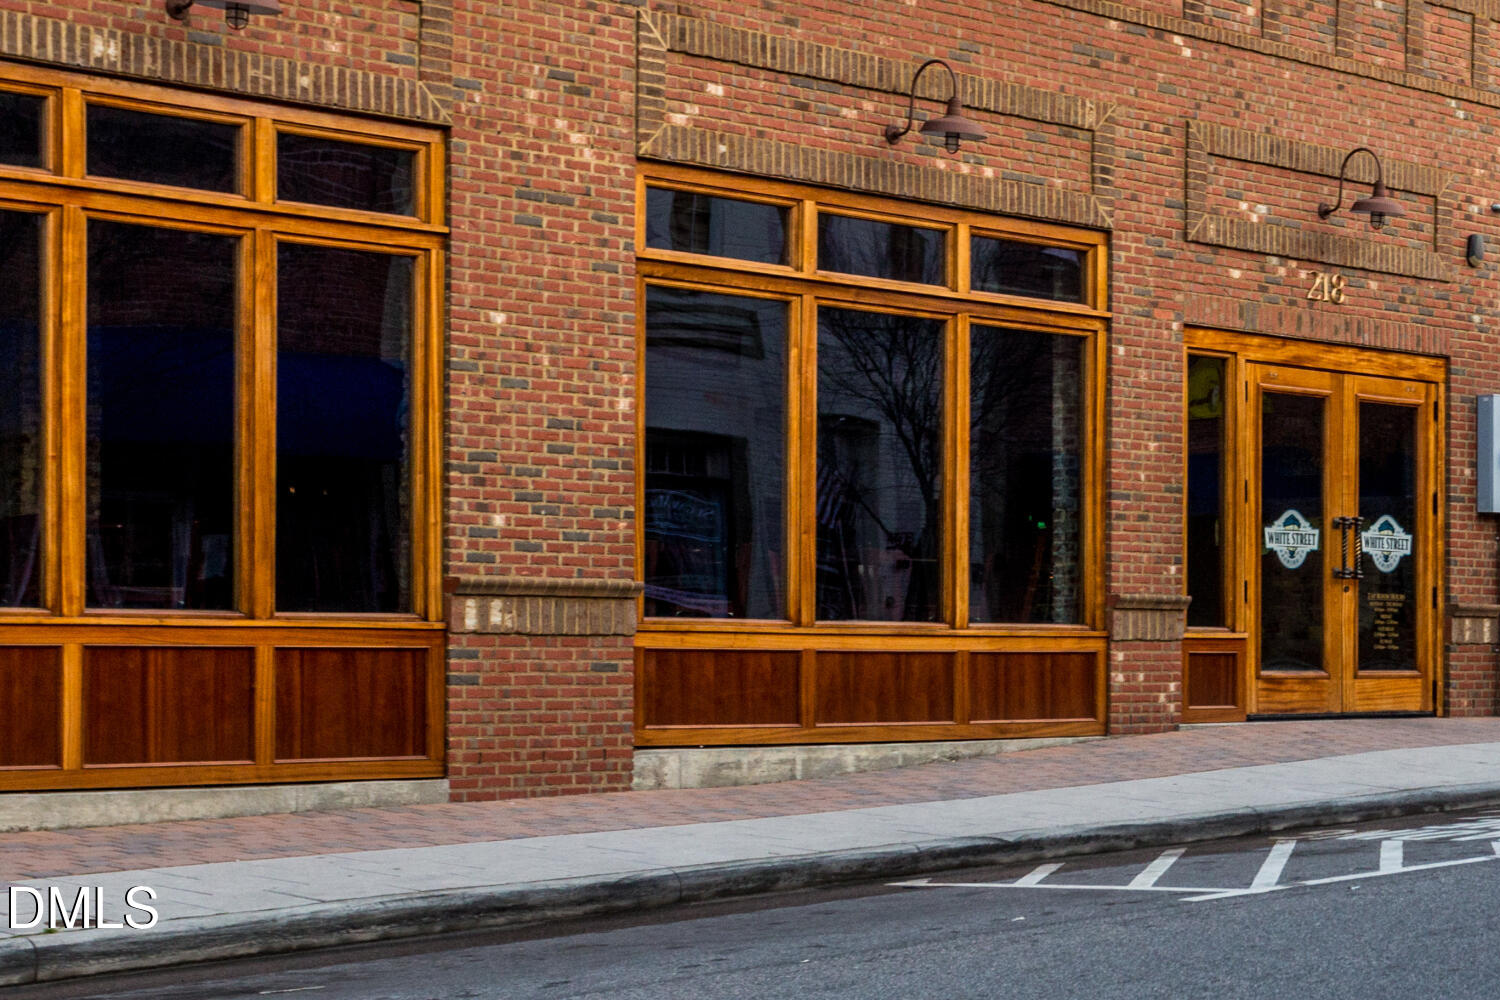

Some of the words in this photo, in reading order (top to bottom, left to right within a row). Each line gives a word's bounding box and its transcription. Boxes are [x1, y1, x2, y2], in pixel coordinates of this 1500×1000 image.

[1306, 270, 1345, 304] 218
[1268, 531, 1290, 546] WHITE
[1291, 532, 1317, 546] STREET
[1364, 535, 1386, 550] WHITE
[1386, 536, 1410, 551] STREET
